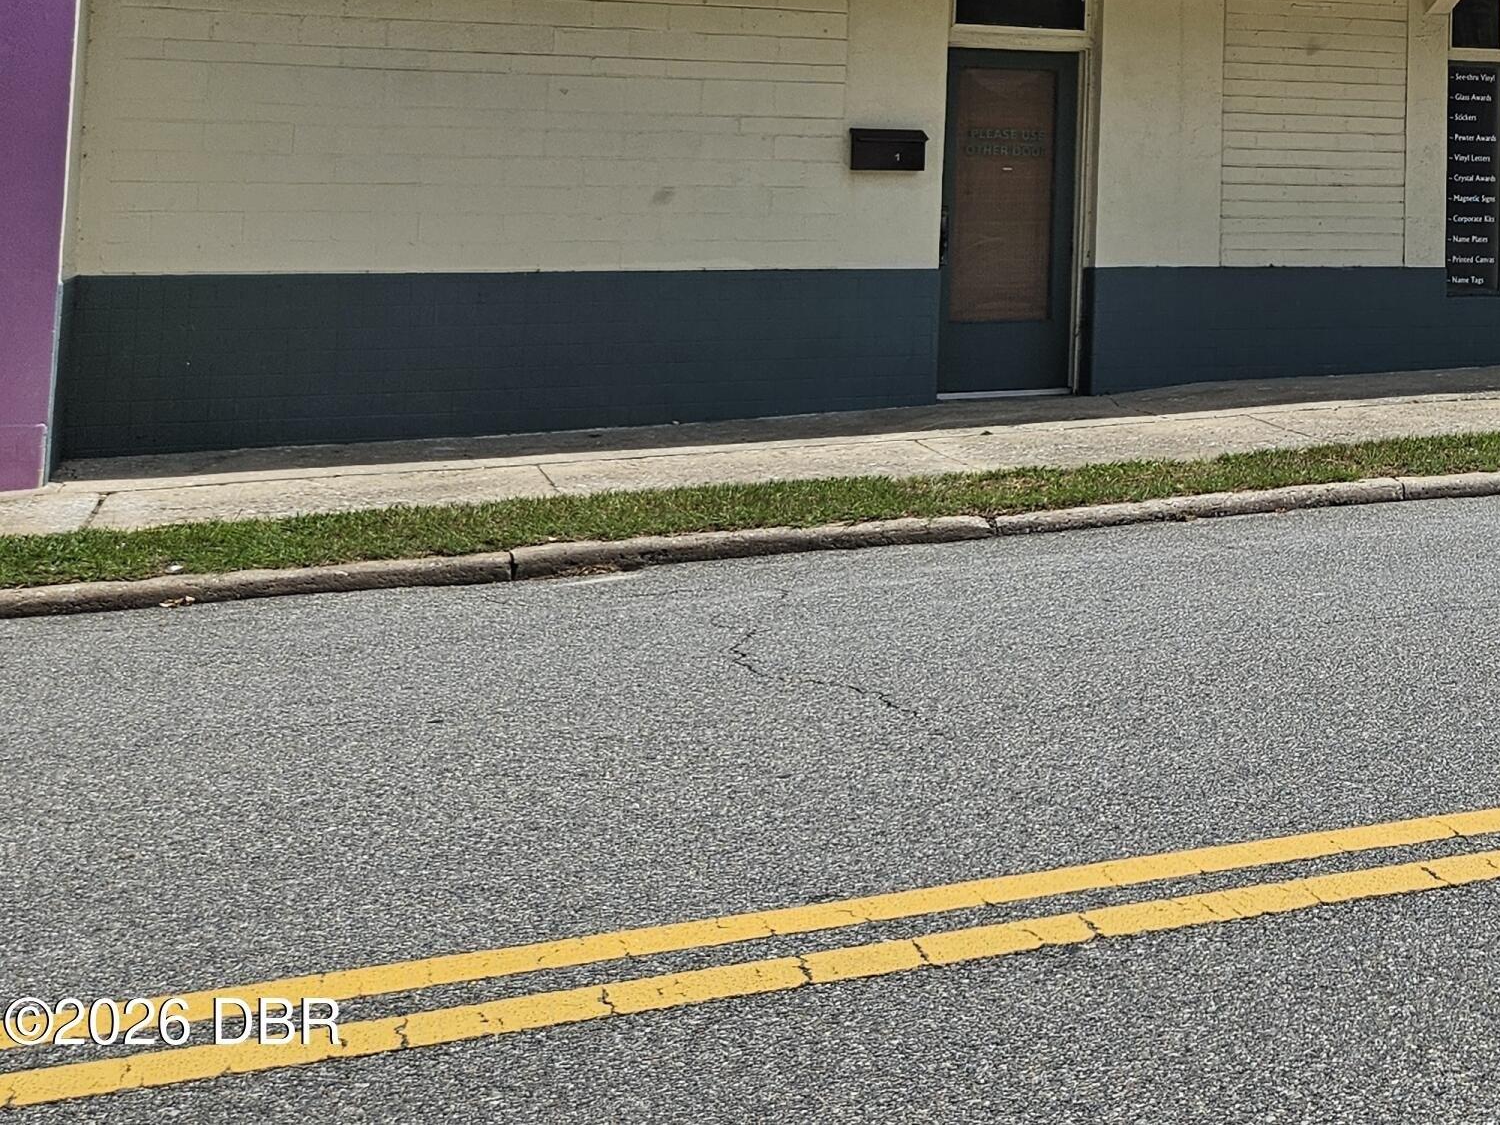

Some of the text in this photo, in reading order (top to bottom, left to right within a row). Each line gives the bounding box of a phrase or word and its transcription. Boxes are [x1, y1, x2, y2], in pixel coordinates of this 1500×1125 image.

[1480, 74, 1495, 83] Vinyl
[1454, 93, 1492, 102] Glass Awards
[1454, 113, 1477, 121] Stickers
[970, 128, 1046, 141] PLEASE USE
[1475, 134, 1497, 142] Awards
[966, 145, 1009, 155] OTHER
[1454, 154, 1470, 162] Vinyl
[1453, 174, 1473, 182] Crystal
[1453, 195, 1496, 203] Magnetic Signs
[1453, 215, 1482, 223] Corporate
[1451, 276, 1484, 284] Name Tags
